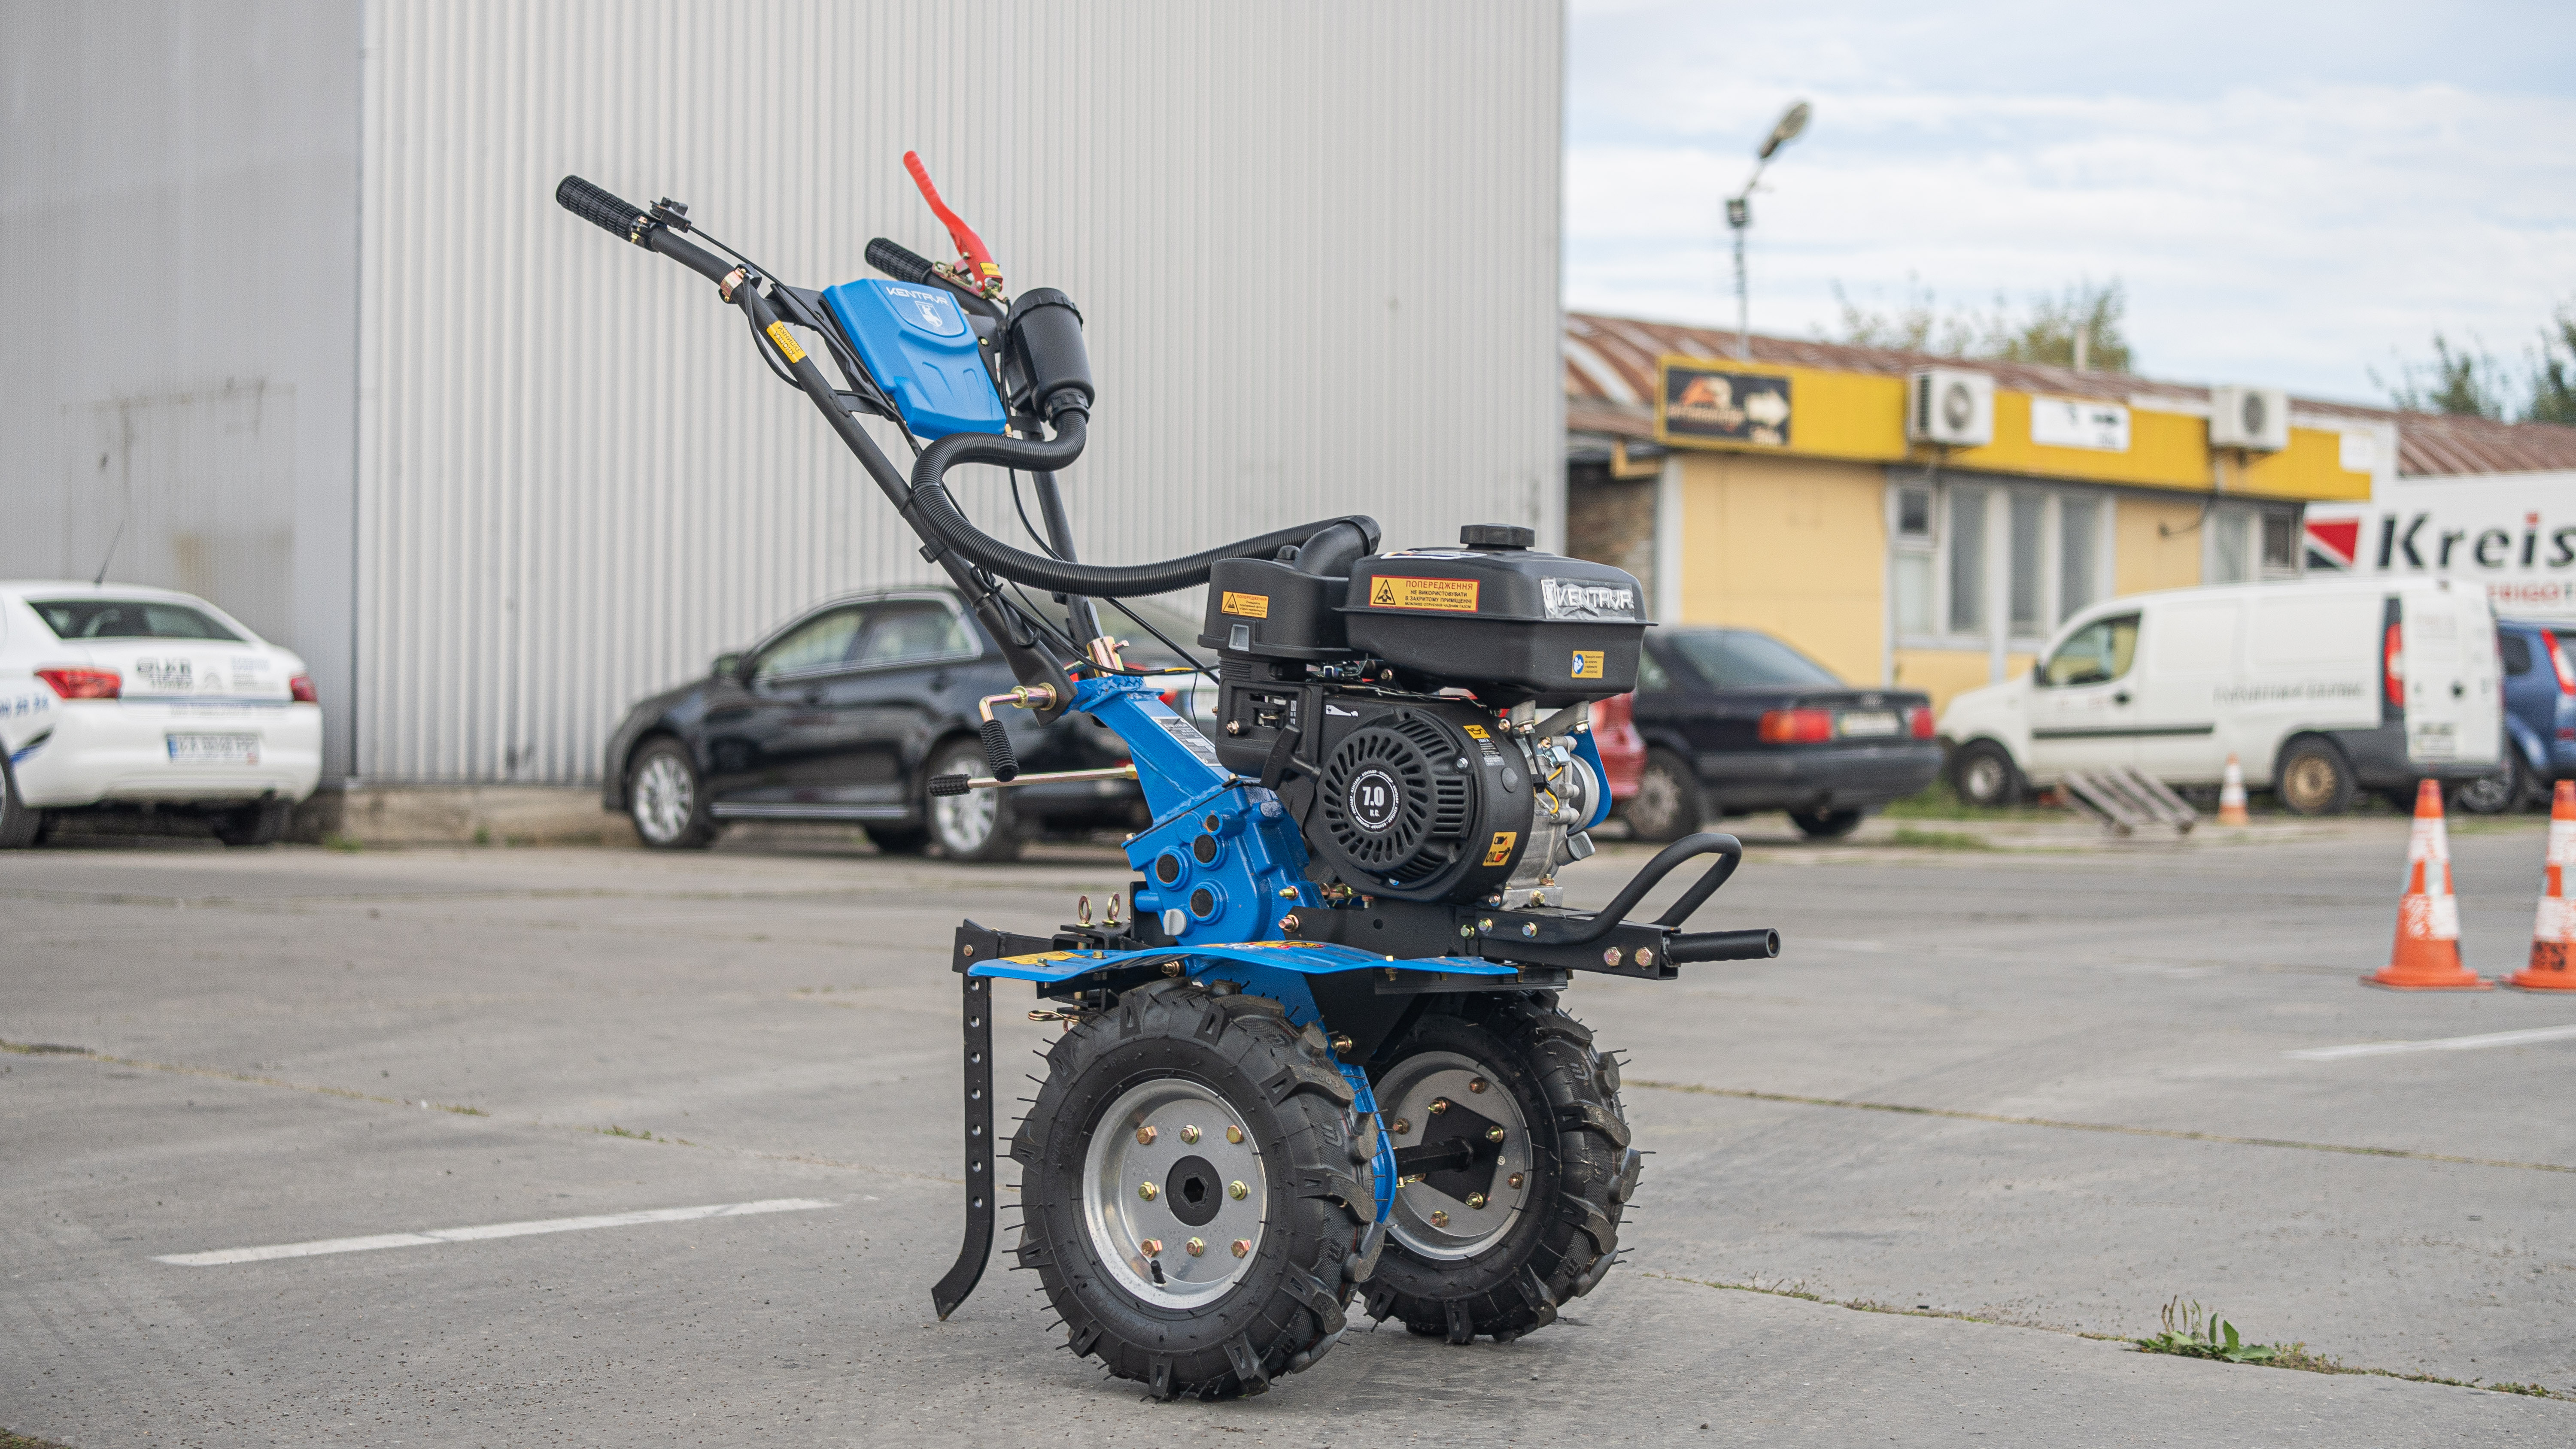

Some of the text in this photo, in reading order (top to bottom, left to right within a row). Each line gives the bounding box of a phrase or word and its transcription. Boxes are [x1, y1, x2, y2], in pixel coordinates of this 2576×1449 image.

[774, 330, 795, 356] КНОПКА
[778, 326, 801, 353] ЗУПИНКИ
[1406, 580, 1473, 590] ПОПЕРЕДЖЕННЯ
[1362, 786, 1384, 807] 7.0
